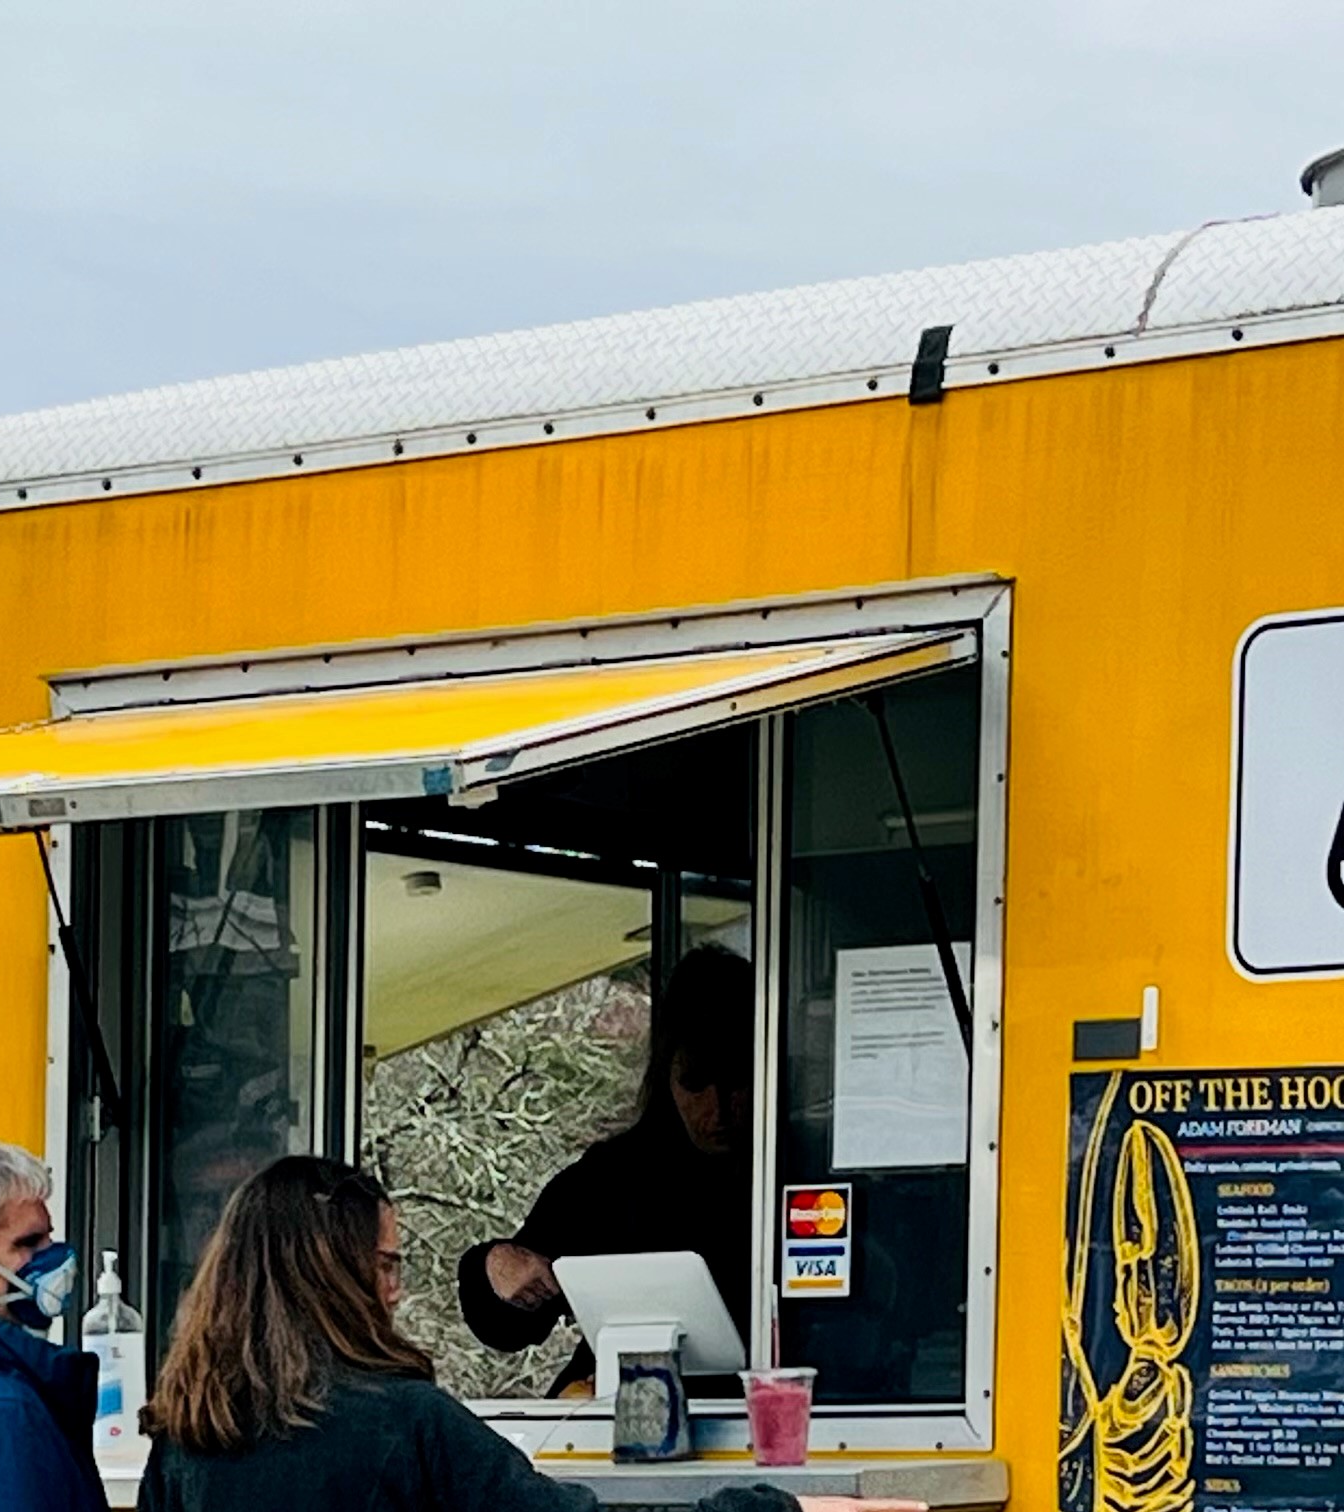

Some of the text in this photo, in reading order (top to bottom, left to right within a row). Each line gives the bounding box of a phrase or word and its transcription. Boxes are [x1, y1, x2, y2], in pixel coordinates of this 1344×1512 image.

[1130, 1080, 1192, 1113] OFF
[1200, 1078, 1272, 1111] THE
[1178, 1122, 1224, 1136] ADAM
[1226, 1119, 1302, 1136] FOREMAN
[796, 1259, 836, 1277] VISA
